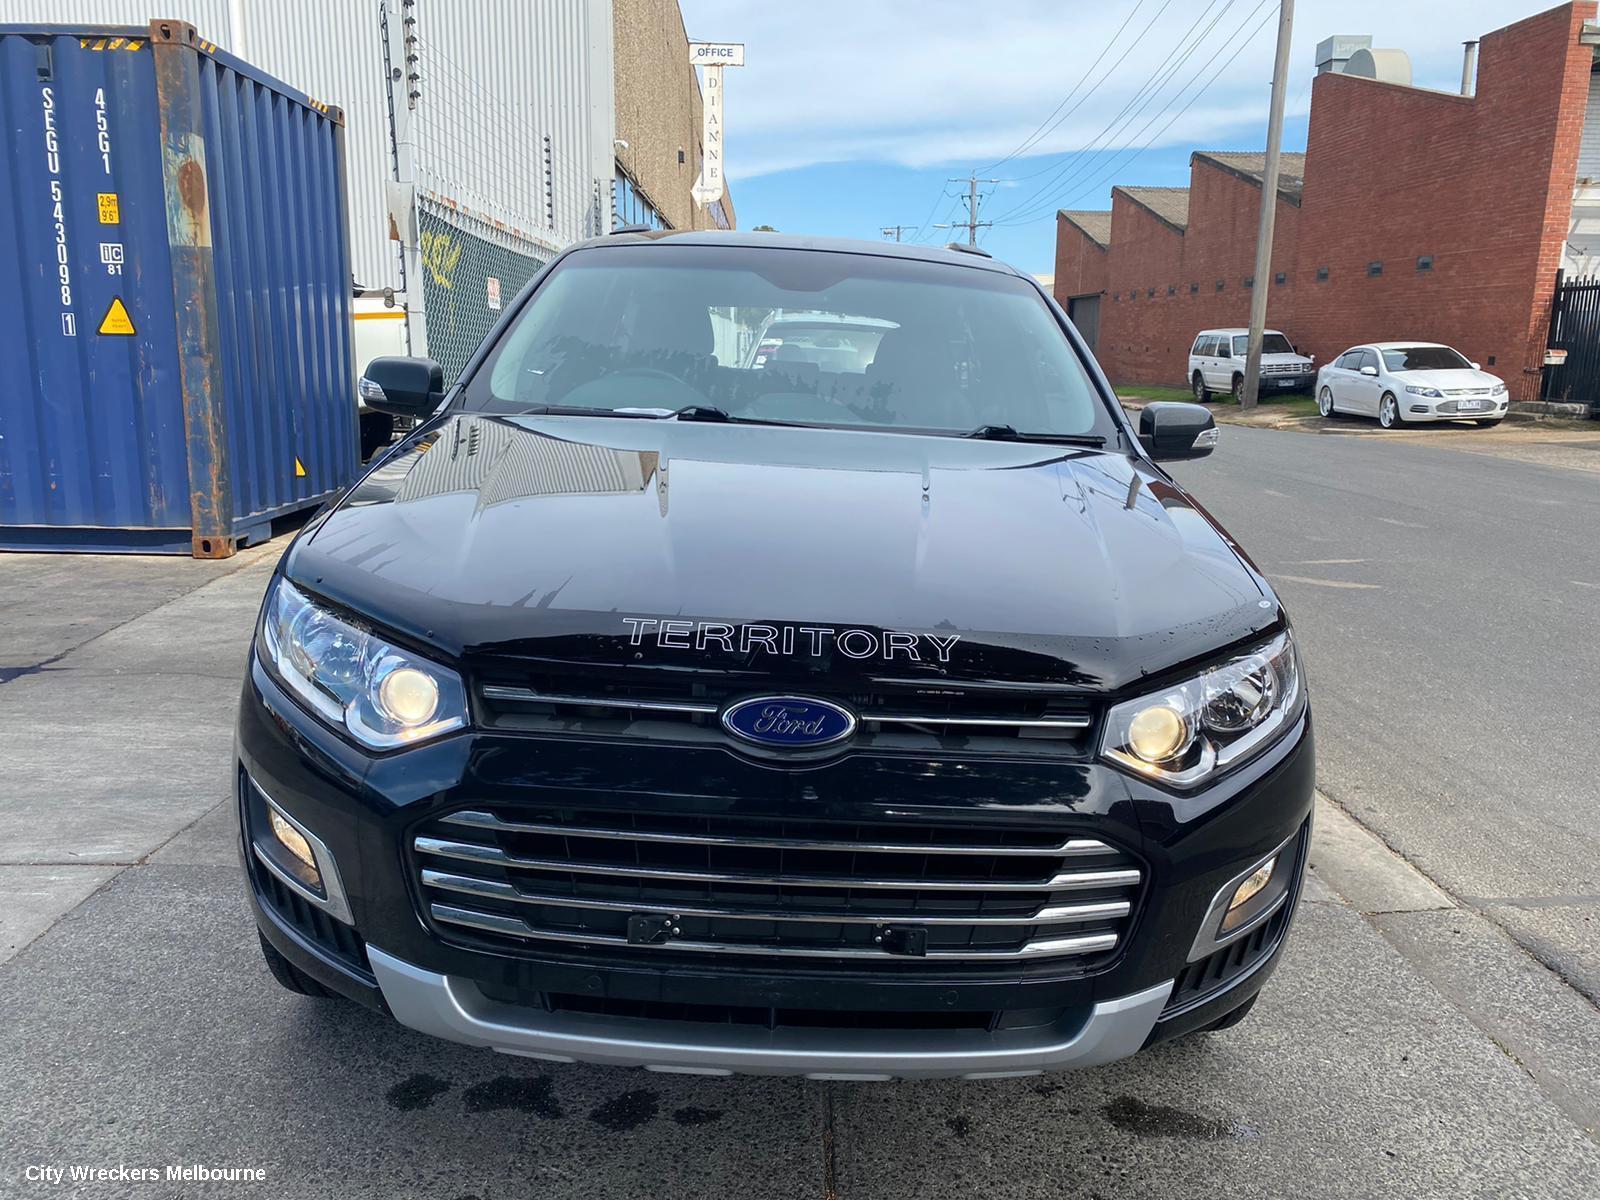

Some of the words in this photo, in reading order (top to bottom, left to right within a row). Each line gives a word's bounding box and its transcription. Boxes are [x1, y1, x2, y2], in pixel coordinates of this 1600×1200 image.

[697, 48, 733, 57] OFFICE
[42, 87, 60, 174] SEGU
[95, 88, 110, 174] 45G1
[709, 78, 719, 178] DIANNE
[50, 180, 72, 306] 543098
[107, 264, 122, 275] 81
[64, 313, 74, 335] 1
[623, 617, 962, 663] TERRITORY
[754, 704, 826, 736] Ford
